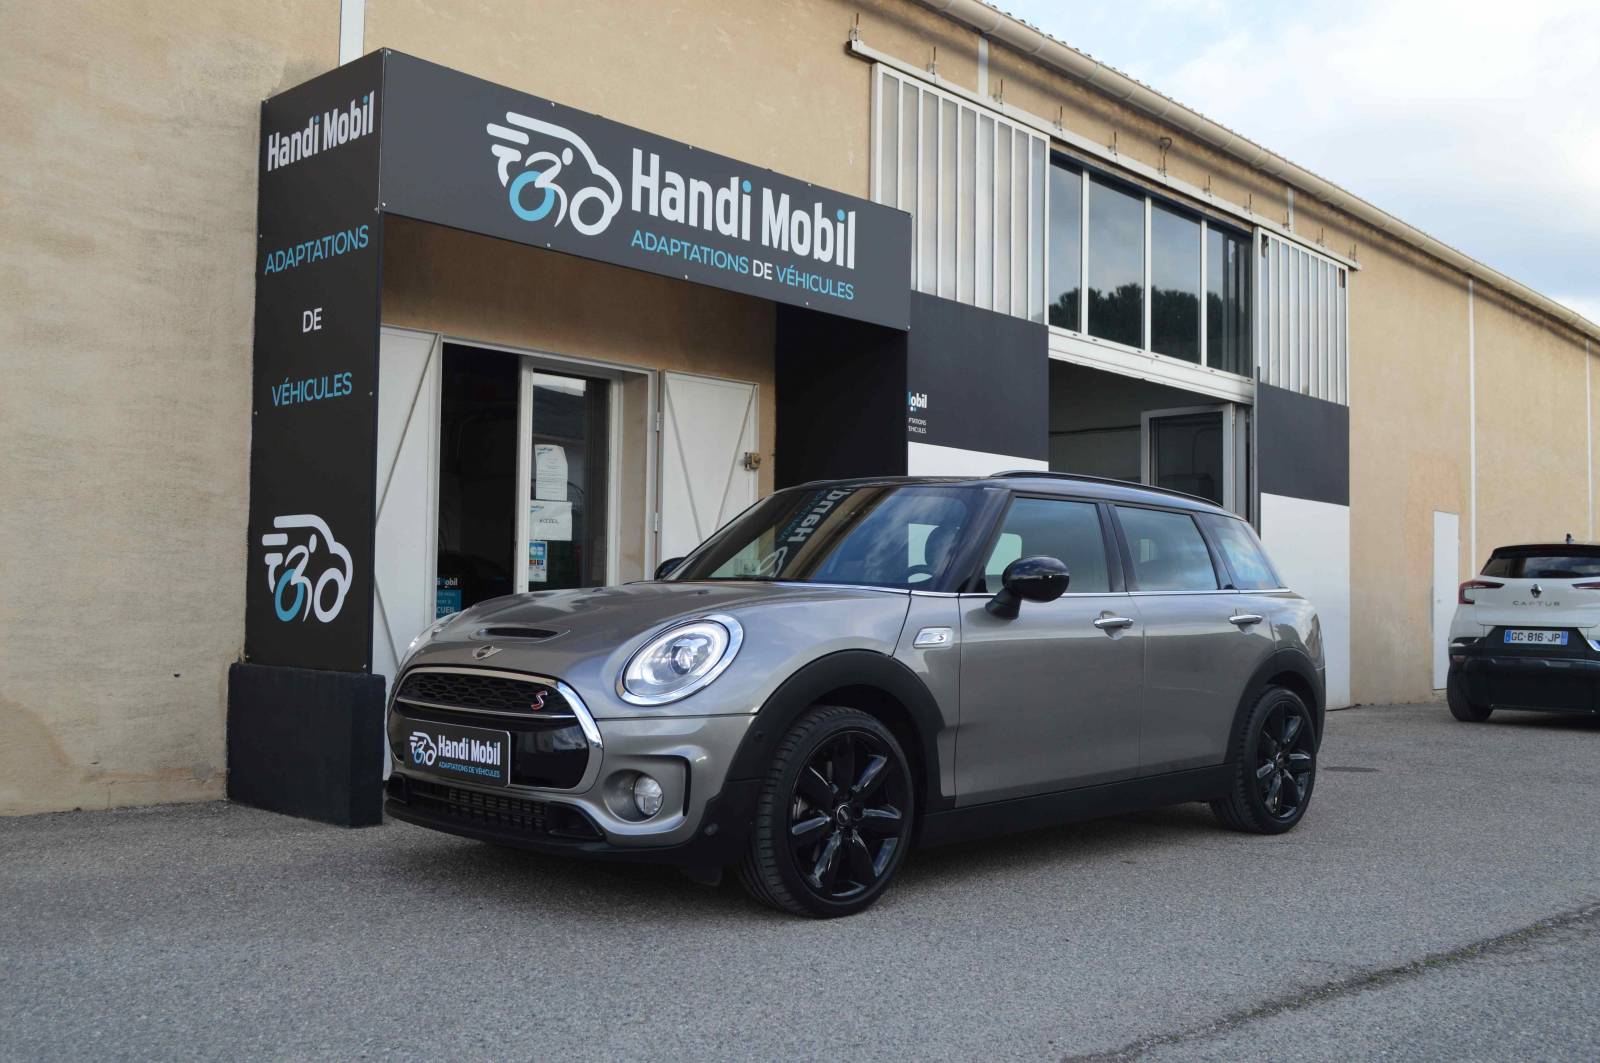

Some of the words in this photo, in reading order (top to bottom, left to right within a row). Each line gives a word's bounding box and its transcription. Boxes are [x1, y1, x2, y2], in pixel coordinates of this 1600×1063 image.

[267, 116, 320, 171] Handi
[323, 91, 374, 150] Mobil
[631, 148, 752, 240] Handi
[761, 188, 856, 269] Mobil
[264, 225, 369, 275] ADAPTATIONS
[631, 230, 749, 274] ADAPTATIONS
[753, 260, 773, 281] DE
[775, 265, 854, 300] VÉHICULES
[302, 308, 323, 333] DE
[272, 372, 352, 406] VÉHICULES
[438, 735, 468, 760] Handi
[471, 739, 500, 765] Mobil
